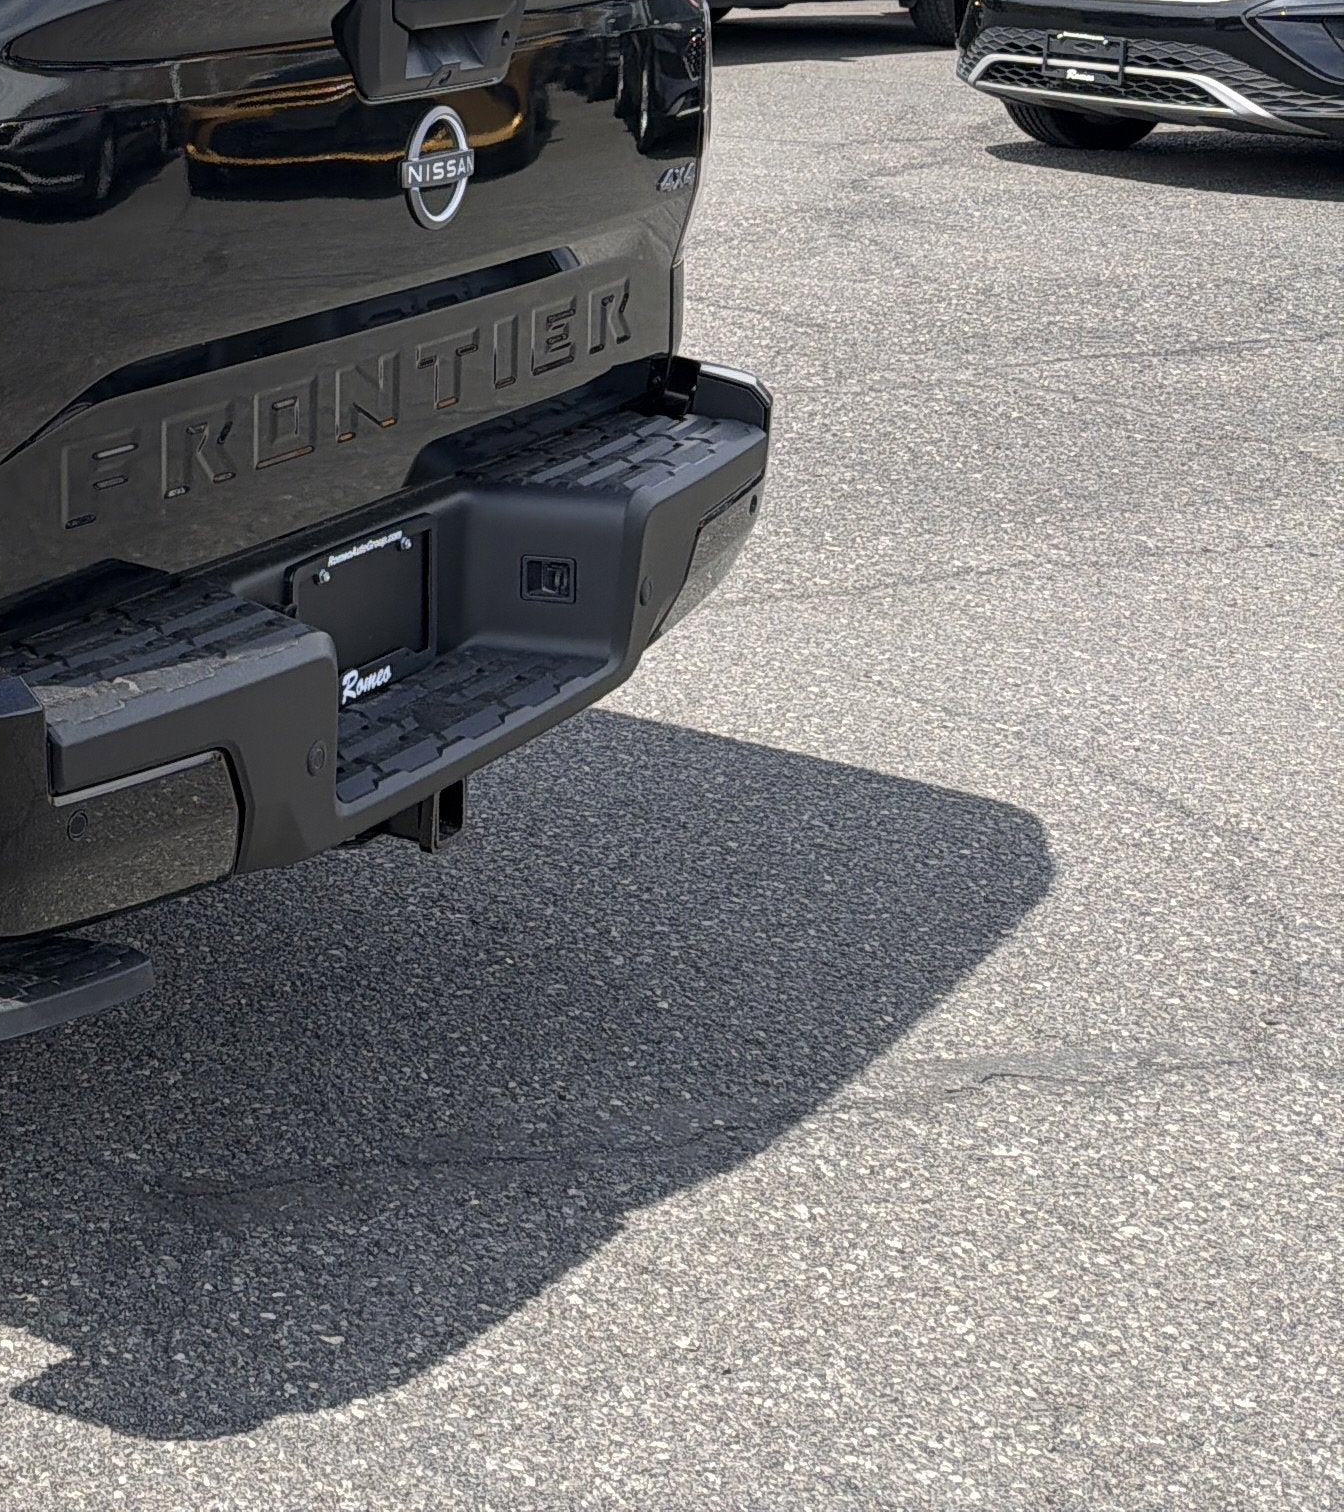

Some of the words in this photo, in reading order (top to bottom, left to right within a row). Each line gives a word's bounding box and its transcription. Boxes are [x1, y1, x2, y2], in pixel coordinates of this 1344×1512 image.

[407, 155, 474, 185] NISSAN
[60, 277, 632, 530] FRONTIER
[341, 664, 392, 705] Romeo
